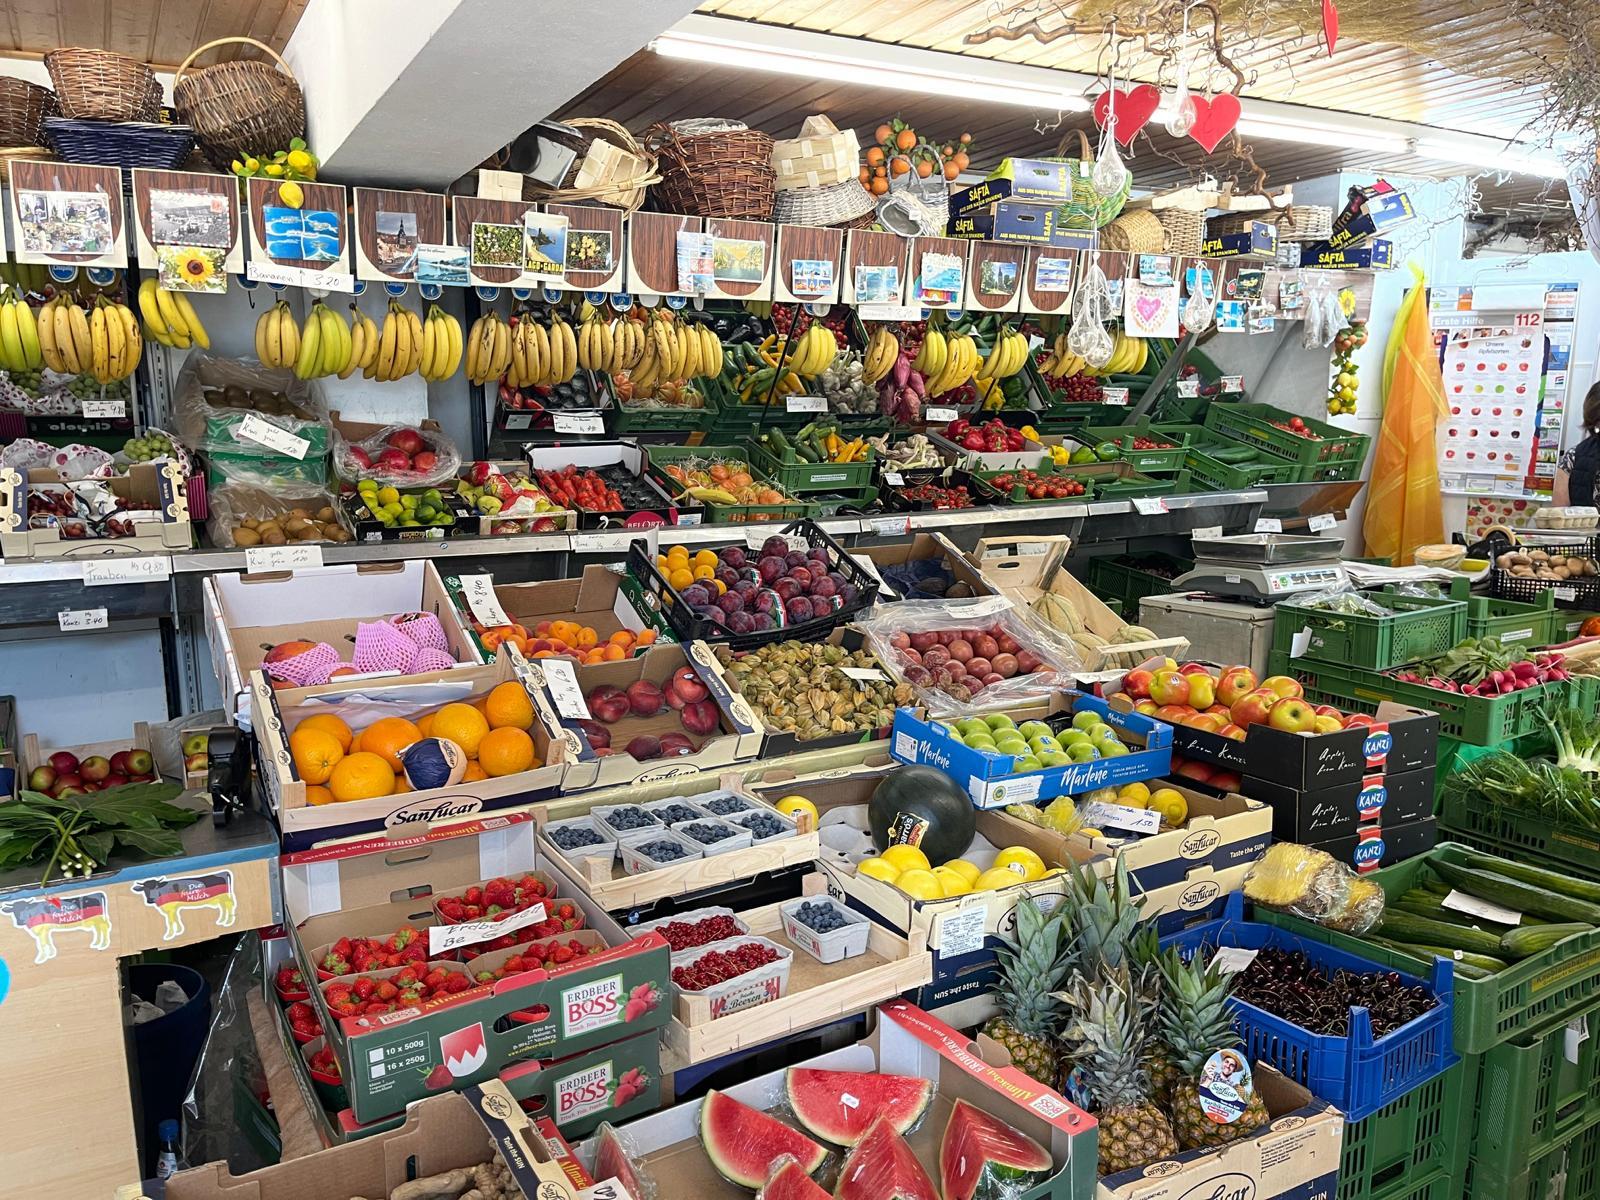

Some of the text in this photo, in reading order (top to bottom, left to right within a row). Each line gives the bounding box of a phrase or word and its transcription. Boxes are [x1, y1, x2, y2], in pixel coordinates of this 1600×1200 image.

[968, 182, 990, 201] SAFTA
[955, 219, 974, 231] SAFTA
[1044, 211, 1053, 236] SAFTA
[1202, 238, 1223, 252] AFTA
[1329, 228, 1352, 248] SAFTA
[1318, 252, 1345, 264] SAFTA
[249, 267, 295, 283] Bananen
[1434, 316, 1484, 326] Erste Hilfe
[1516, 313, 1540, 326] 112
[87, 568, 127, 582] Trauben
[918, 740, 950, 768] Marlene
[1060, 764, 1108, 794] Marlene
[393, 801, 479, 825] SanLucar
[1183, 834, 1218, 855] SanLucar
[1230, 843, 1265, 859] Taste the SUN
[187, 892, 210, 902] Milch
[1183, 886, 1218, 907] SanLucar
[59, 914, 82, 923] Milch
[568, 981, 616, 1003] ERDBEER
[934, 981, 979, 1000] Taste the SUN
[569, 992, 617, 1023] BOSS
[729, 994, 761, 1010] Beeren
[386, 1047, 395, 1056] 10
[404, 1039, 424, 1051] 500g
[942, 1034, 986, 1073] ERDBEEREN
[387, 1062, 396, 1071] 16
[405, 1054, 426, 1066] 250g
[560, 1067, 607, 1093] ERDBEER
[561, 1078, 607, 1112] BOSS
[503, 1136, 512, 1151] Taste
[514, 1156, 525, 1170] SUN
